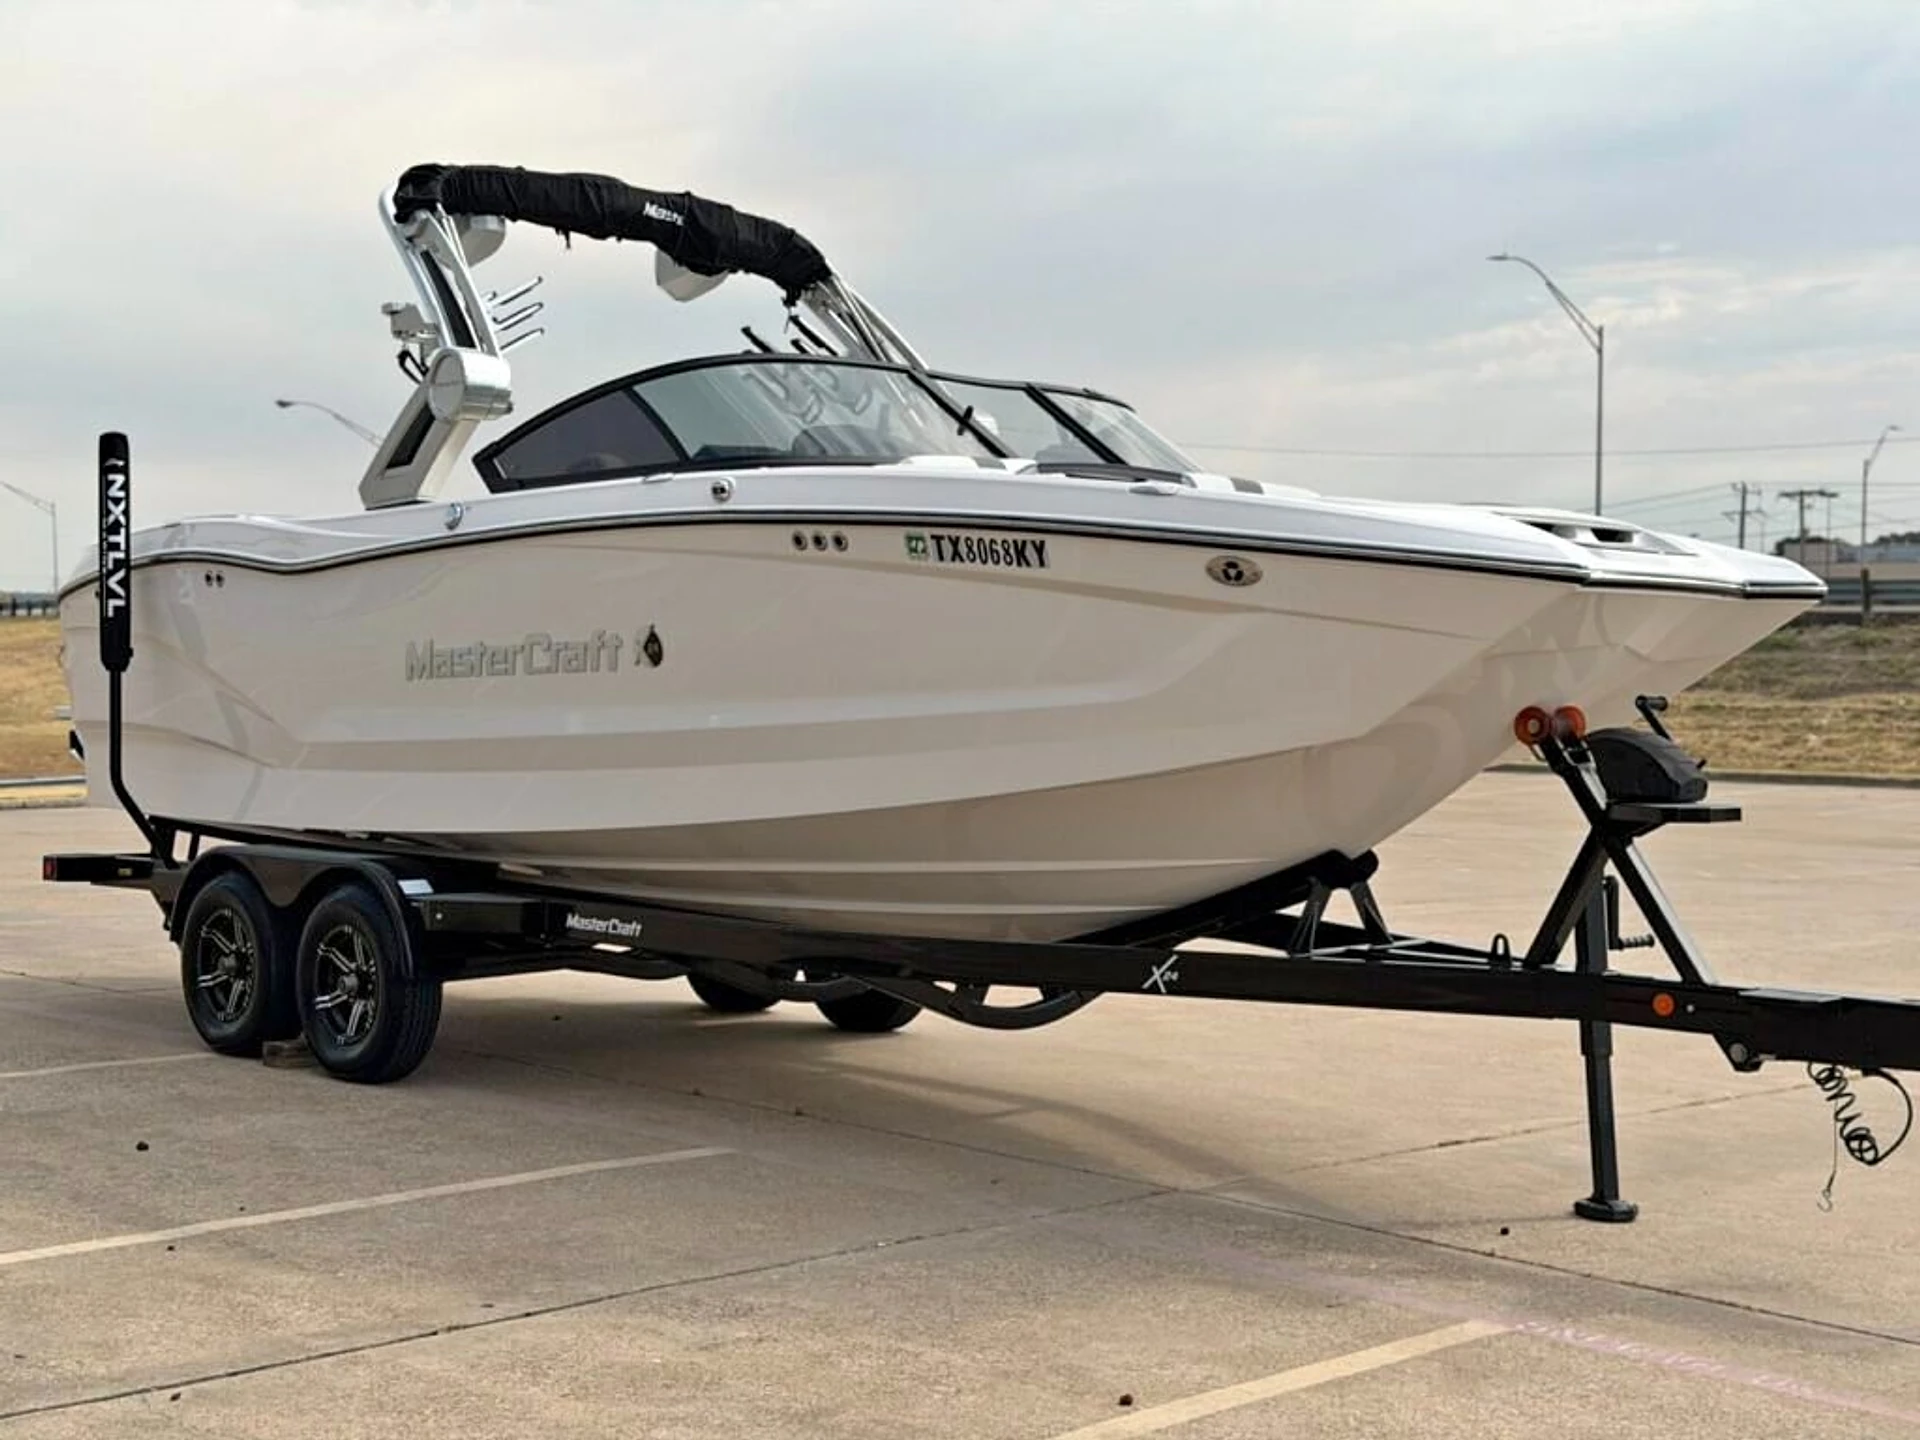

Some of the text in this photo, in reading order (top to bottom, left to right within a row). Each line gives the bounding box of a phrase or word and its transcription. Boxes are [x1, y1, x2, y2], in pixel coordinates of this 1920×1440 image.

[106, 473, 127, 619] NXTLVL
[930, 533, 1047, 568] TX8068KY
[405, 629, 624, 682] MasterCraft
[565, 912, 642, 937] MasterCraft
